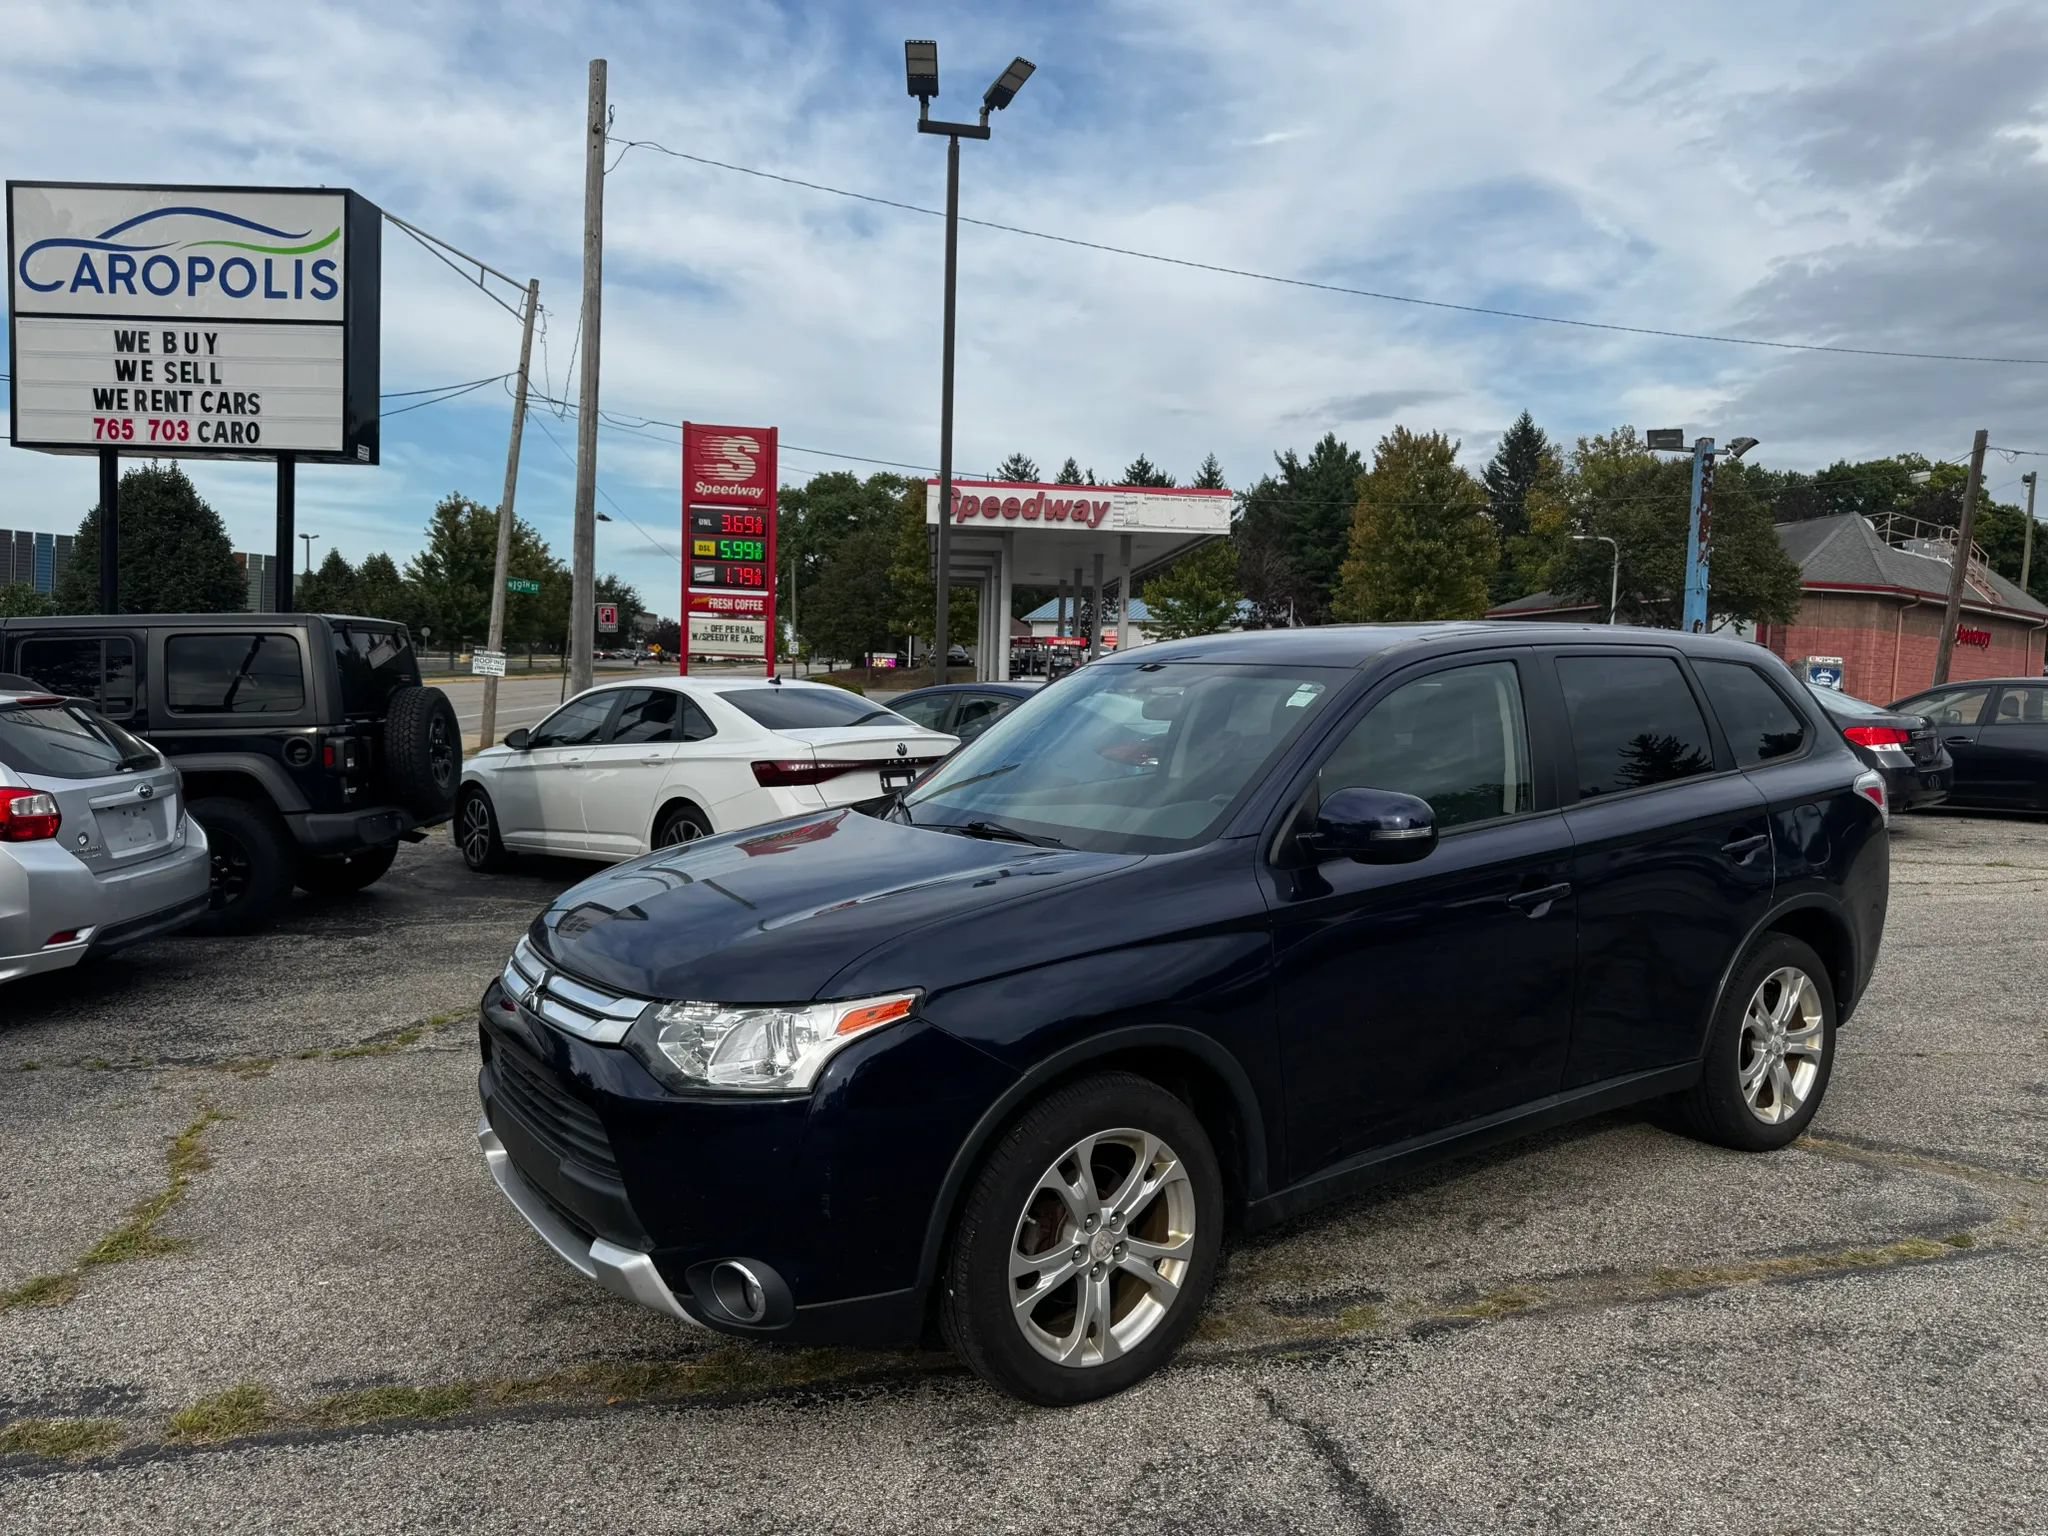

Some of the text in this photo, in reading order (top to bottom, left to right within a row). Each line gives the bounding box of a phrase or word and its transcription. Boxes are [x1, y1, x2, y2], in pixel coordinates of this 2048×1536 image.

[19, 238, 340, 301] CAROPOLIS
[114, 330, 219, 355] WE BUY
[115, 359, 223, 385] WE SELL
[93, 388, 261, 415] WE RENT CARS
[93, 417, 261, 444] 765 703 CARO
[694, 481, 764, 499] Speedway
[708, 598, 733, 610] FRESH
[734, 599, 763, 611] COFFEE
[710, 625, 724, 633] OFF
